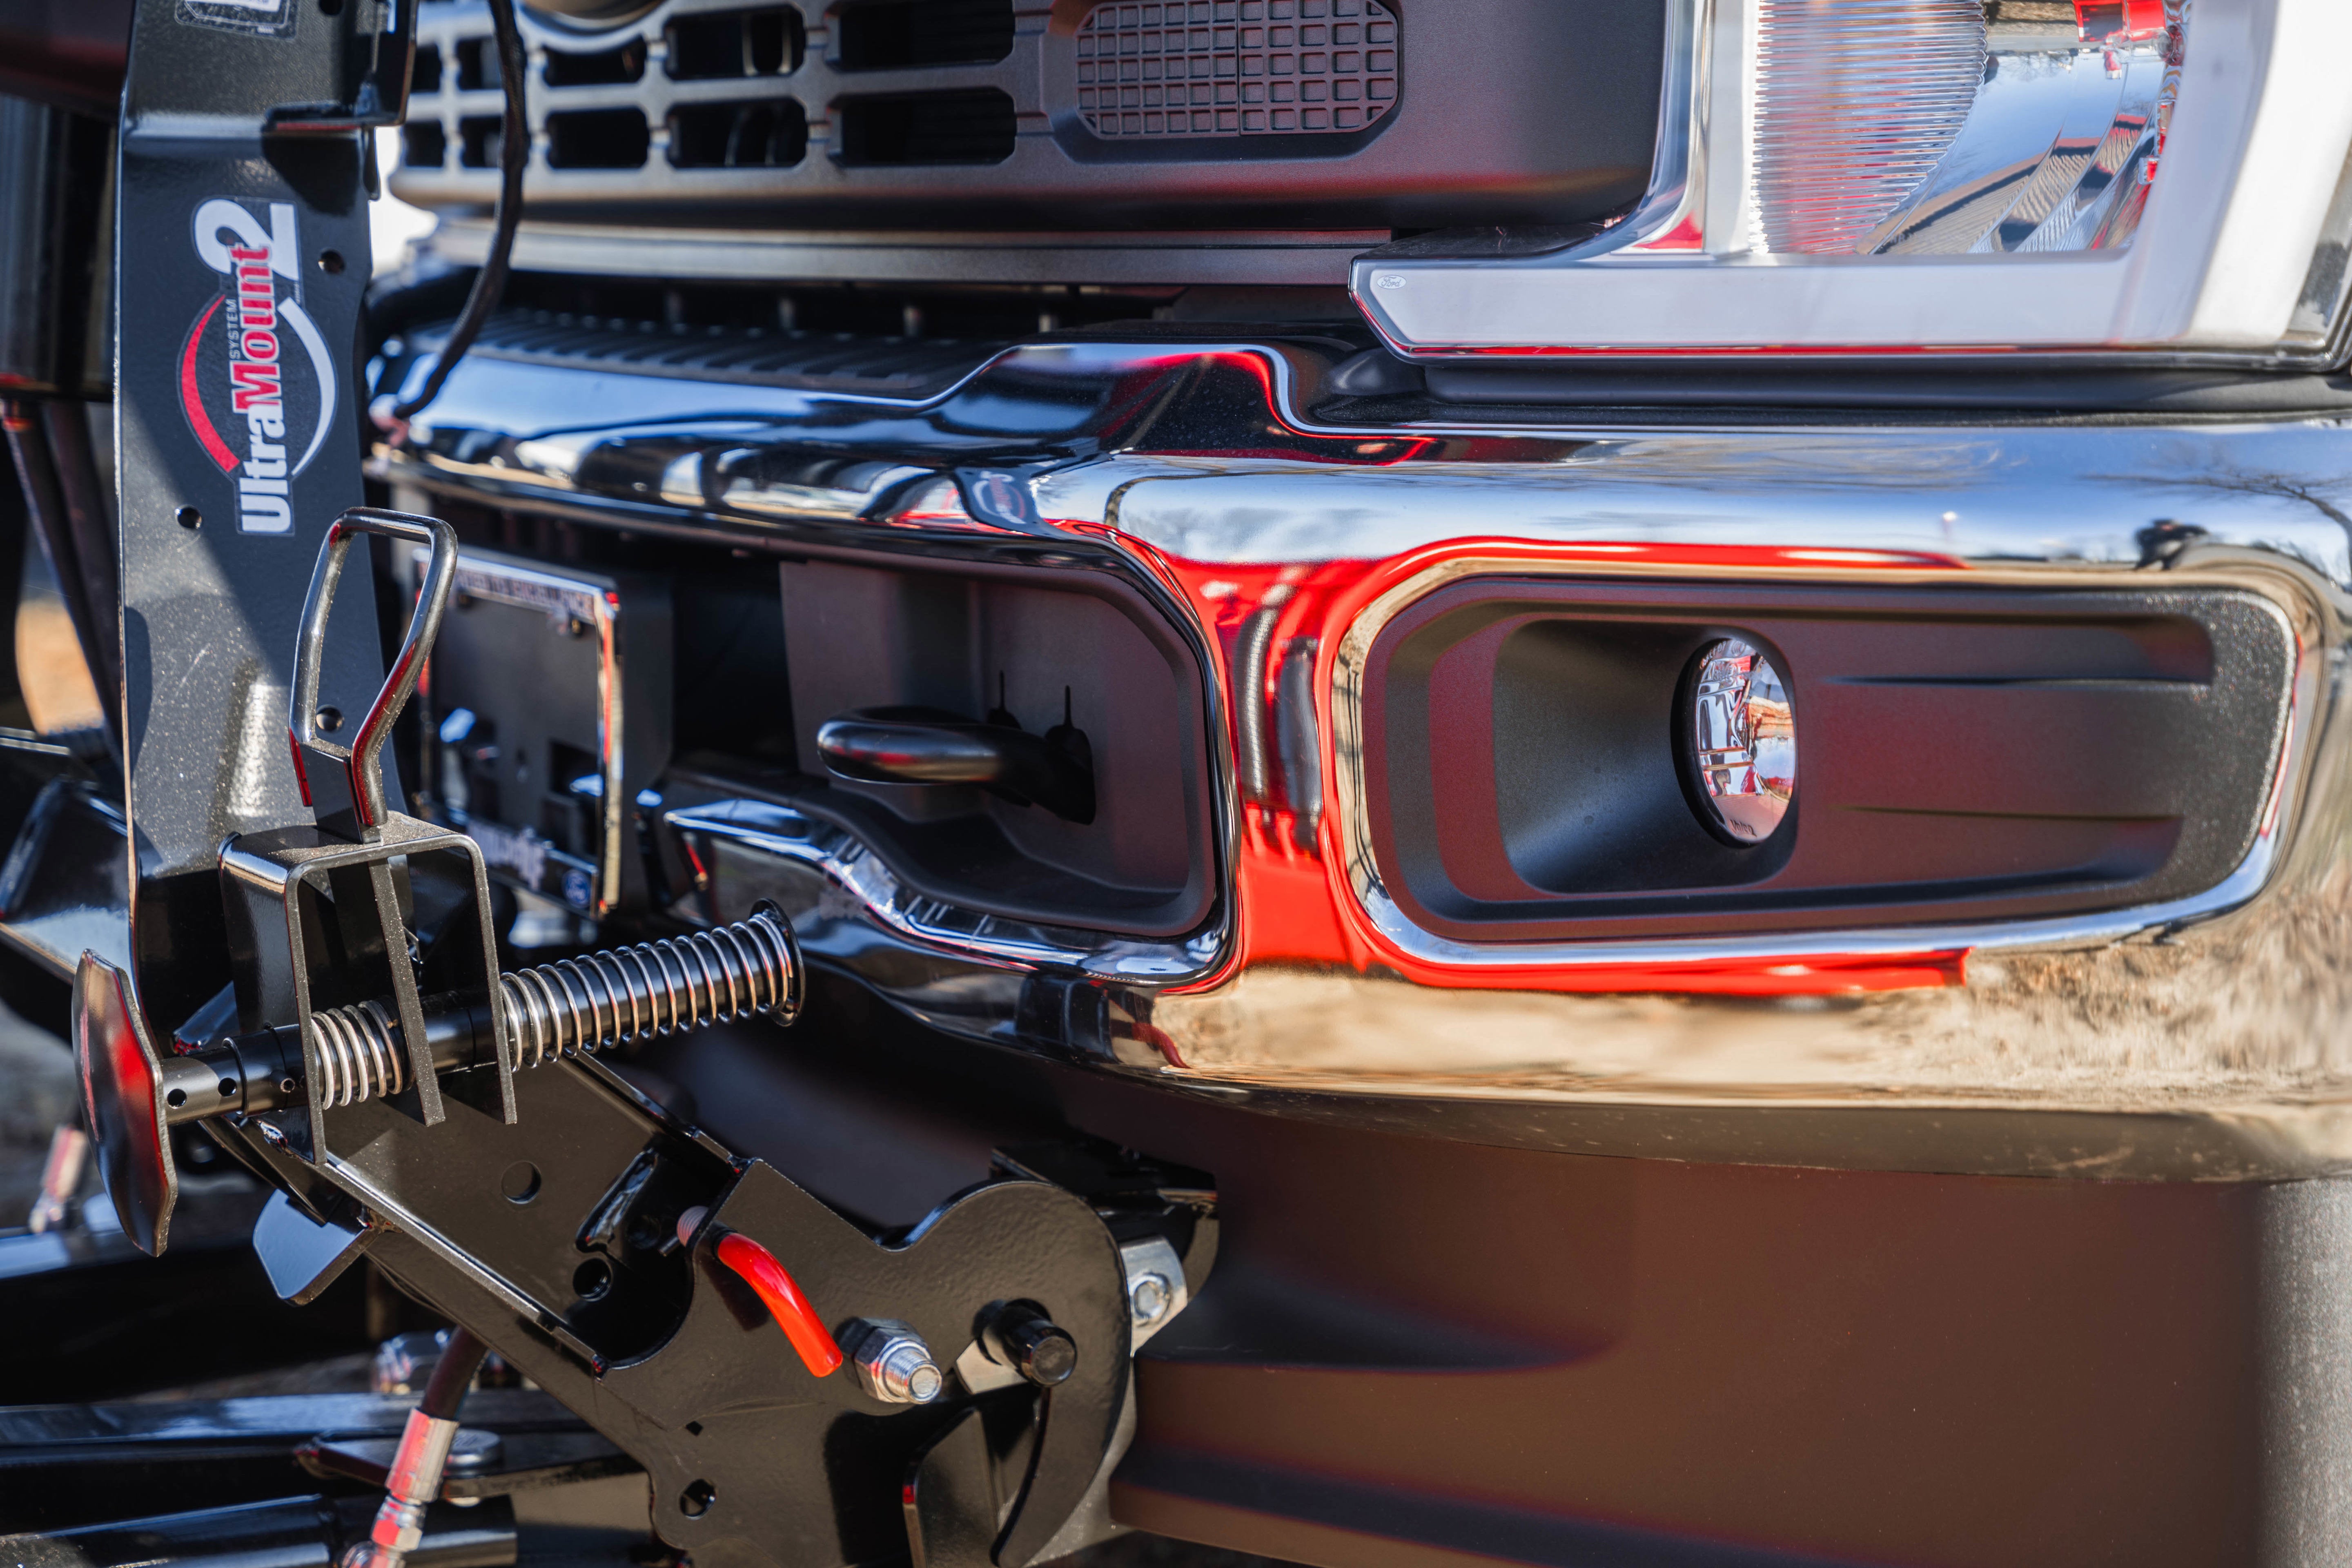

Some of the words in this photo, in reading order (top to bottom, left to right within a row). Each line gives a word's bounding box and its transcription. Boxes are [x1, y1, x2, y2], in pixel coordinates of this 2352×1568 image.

[194, 198, 299, 281] 2
[1381, 276, 1401, 287] Ford
[226, 298, 241, 359] SYSTEM
[229, 243, 291, 531] UltraMount
